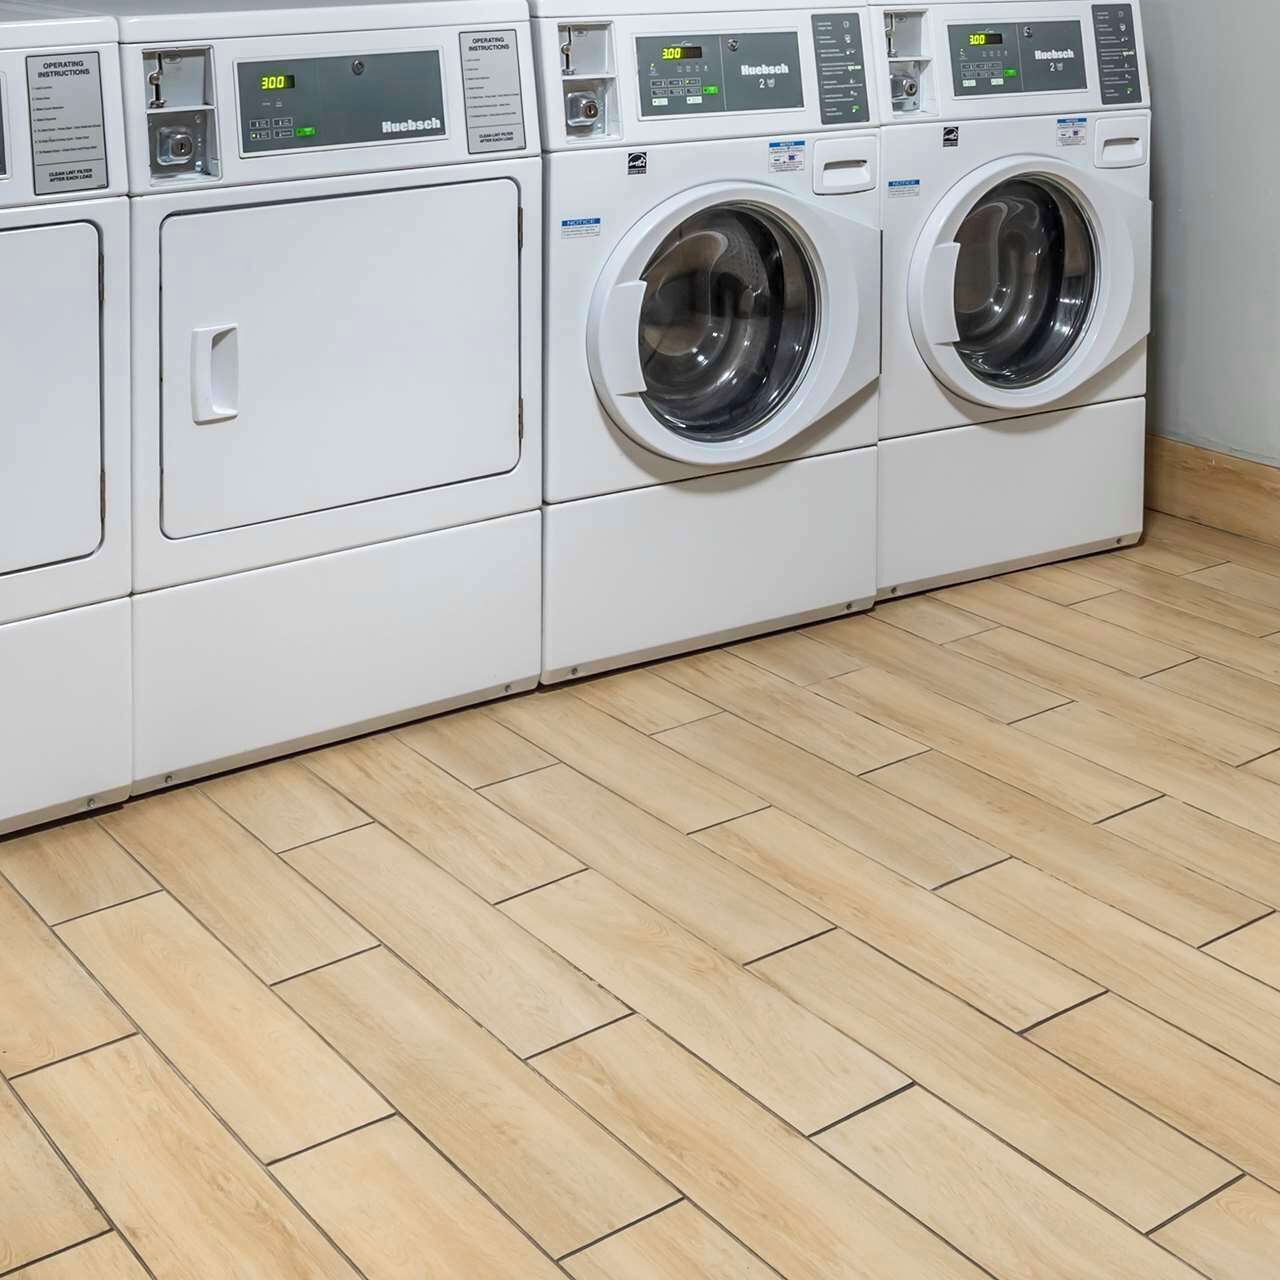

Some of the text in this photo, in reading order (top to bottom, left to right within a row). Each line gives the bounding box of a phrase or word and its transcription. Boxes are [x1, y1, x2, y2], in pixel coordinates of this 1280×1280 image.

[1034, 49, 1075, 60] Huebsch
[43, 60, 84, 69] OPERATING
[741, 63, 789, 76] Huebsch
[37, 68, 90, 78] INSTRUCTIONS
[759, 78, 765, 89] 2
[381, 117, 441, 133] Huebsch
